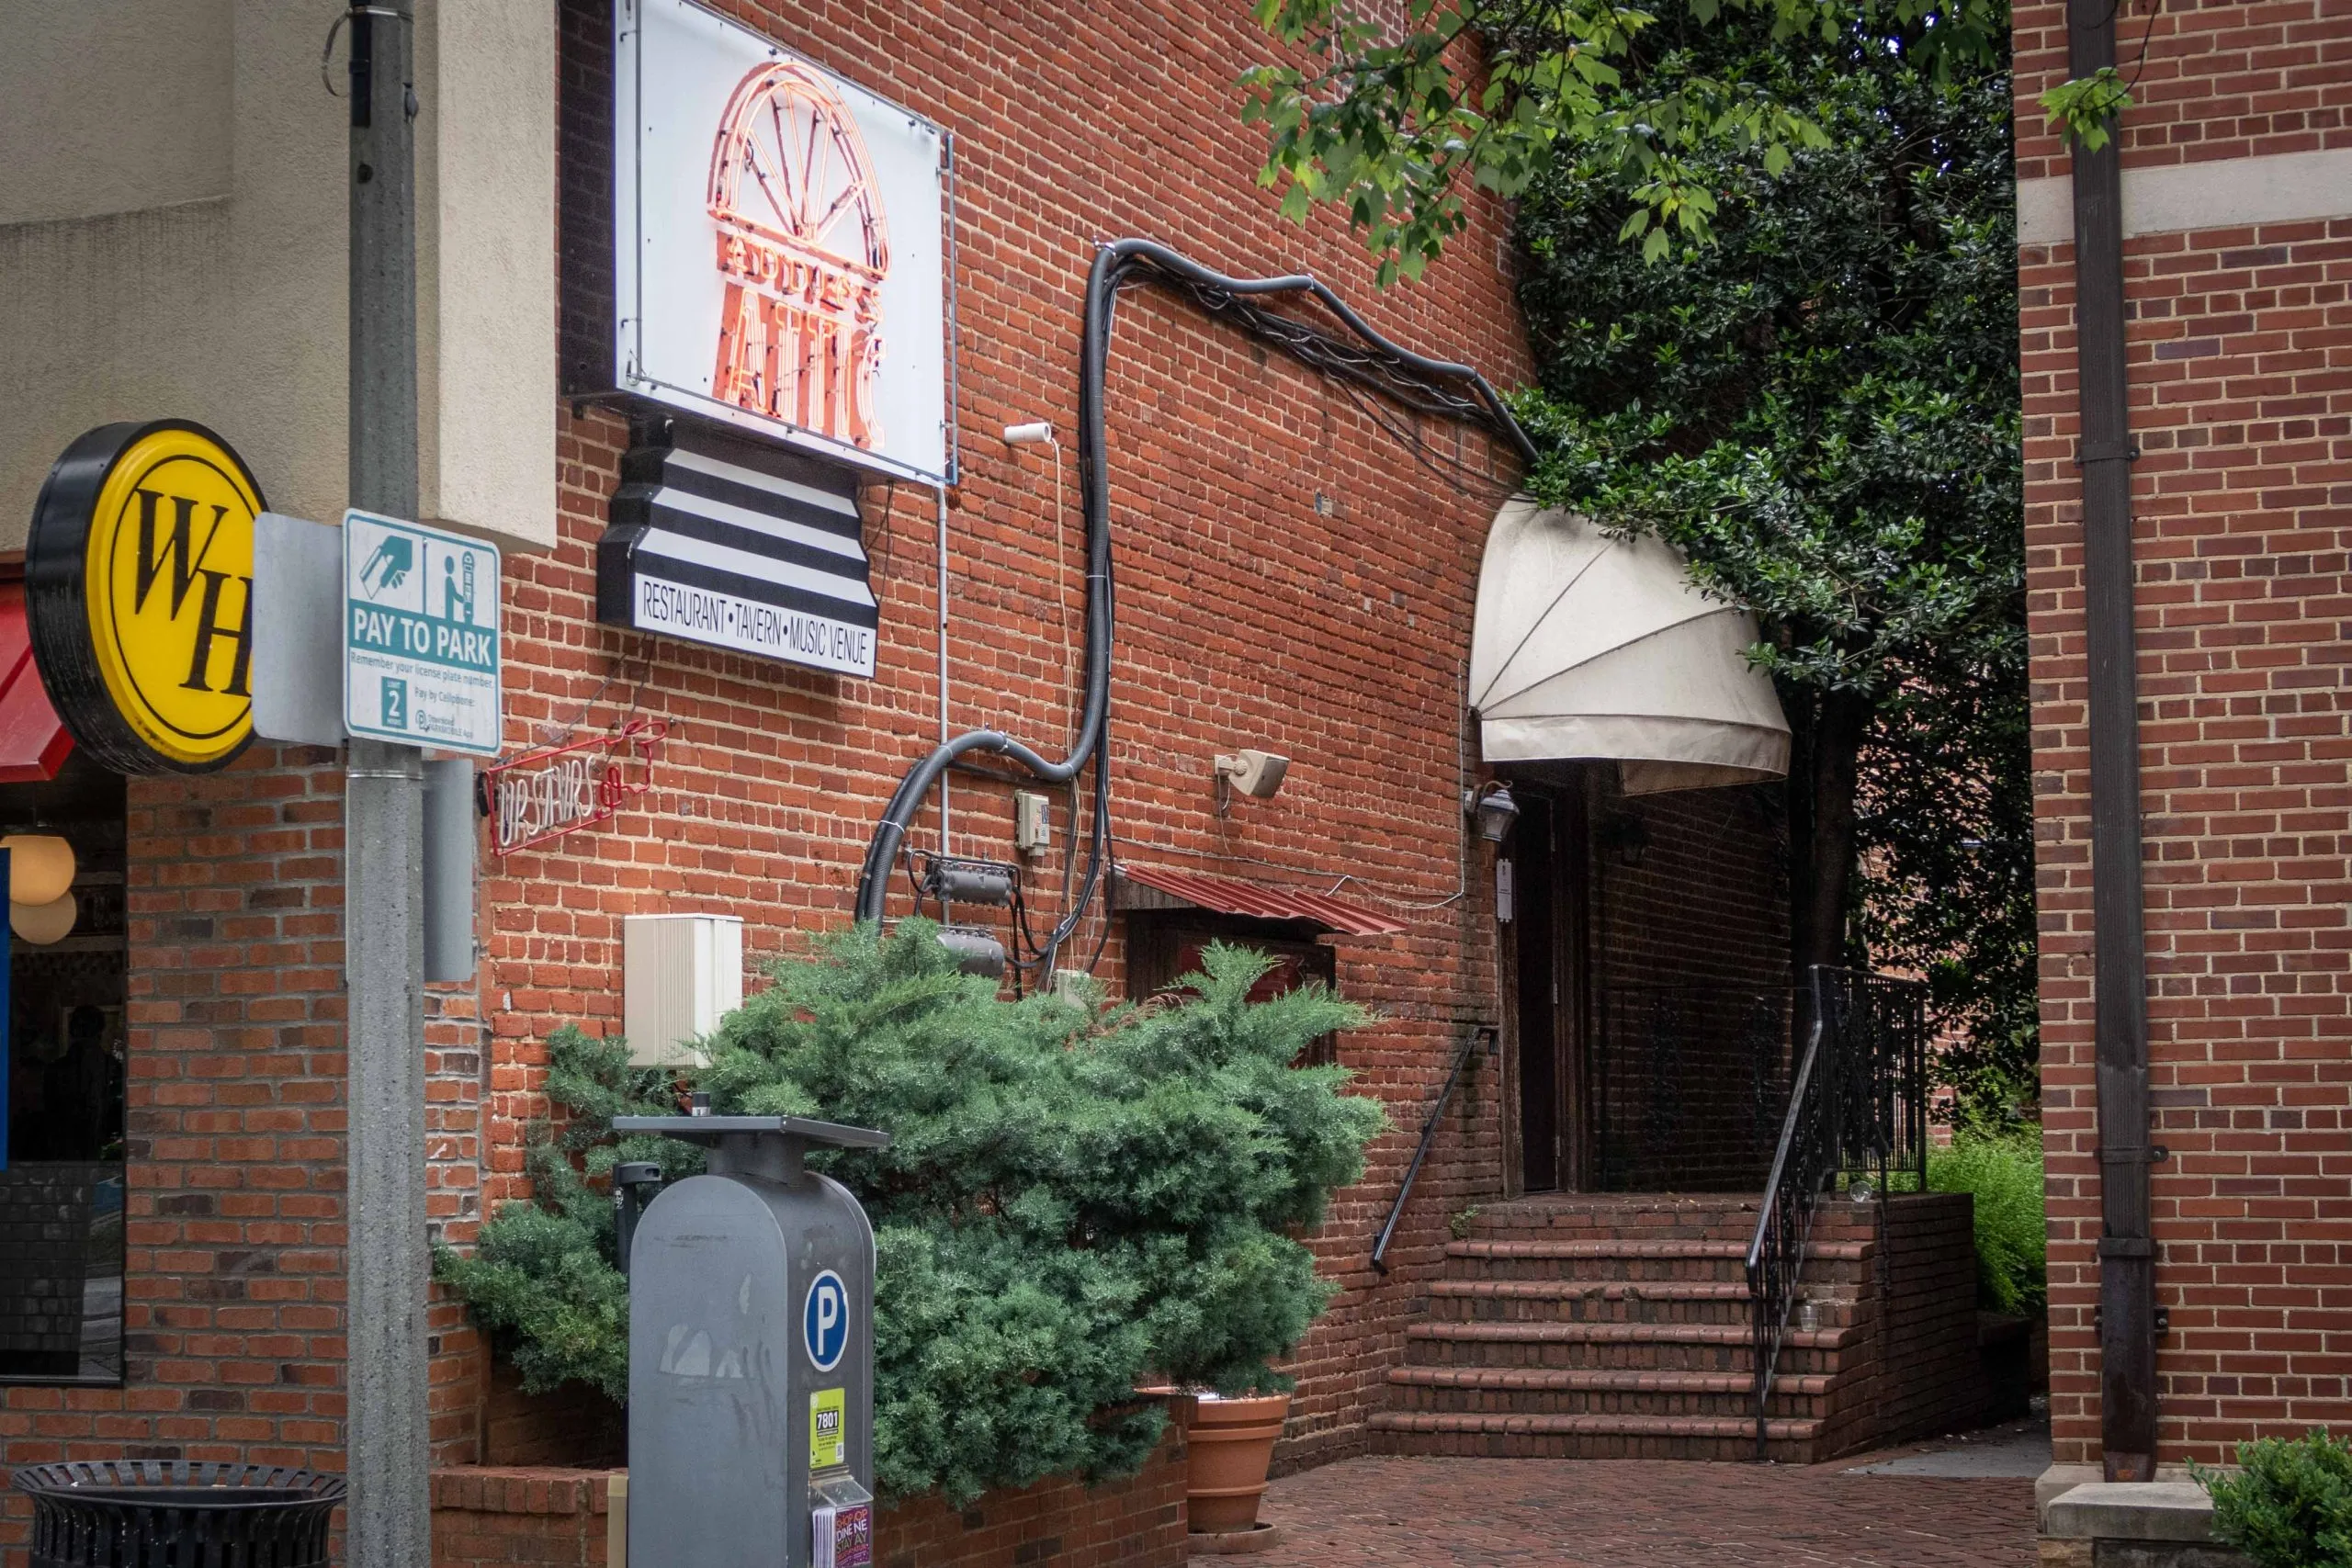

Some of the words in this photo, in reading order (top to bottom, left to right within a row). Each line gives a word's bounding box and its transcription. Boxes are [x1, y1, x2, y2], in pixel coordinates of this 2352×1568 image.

[712, 281, 887, 449] ATTIC
[354, 608, 395, 647] PAY
[400, 618, 430, 654] TO
[436, 626, 492, 667] PARK
[643, 581, 727, 634] RESTAURANT
[735, 603, 781, 648] TAVERN
[789, 616, 827, 656] MUSIC
[830, 625, 867, 665] VENUE
[350, 652, 393, 671] Remember
[396, 662, 413, 675] your
[414, 664, 441, 680] license
[442, 671, 462, 685] plate
[389, 690, 401, 717] 2
[414, 686, 427, 702] Pay
[429, 689, 437, 704] by
[817, 1286, 837, 1356] P
[817, 1411, 838, 1430] 7801
[836, 1523, 853, 1541] DINE
[836, 1536, 853, 1552] STAY
